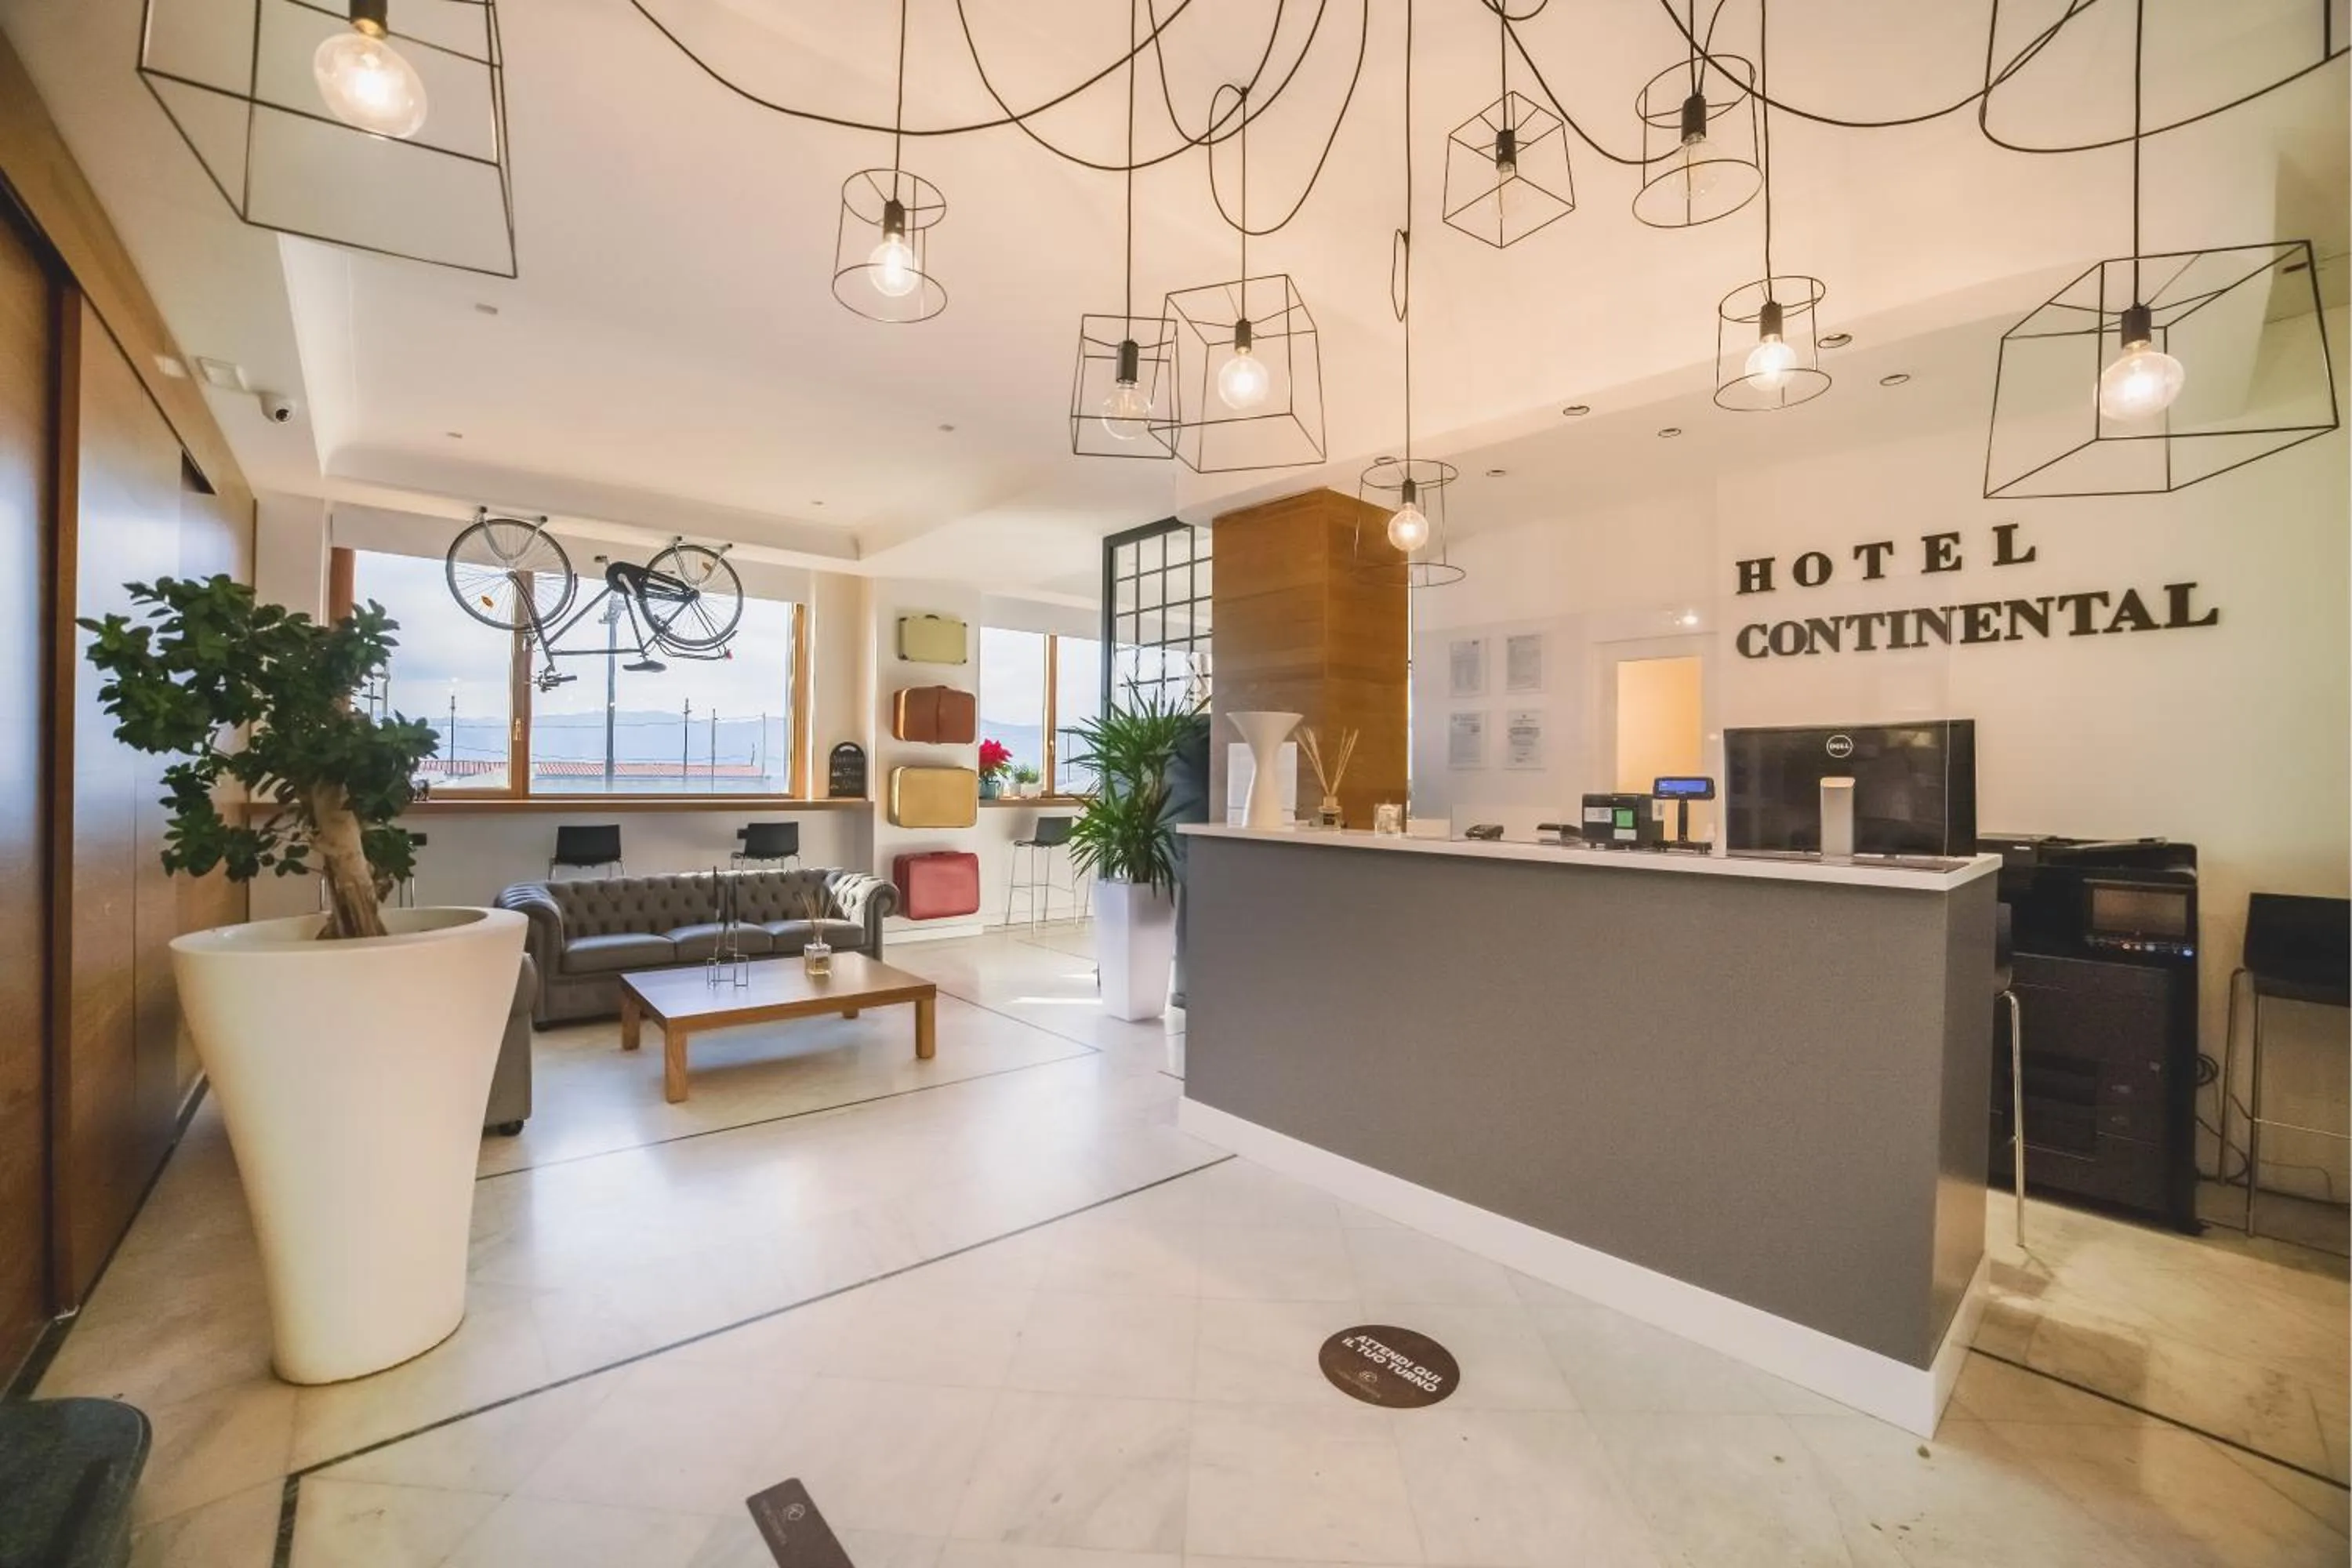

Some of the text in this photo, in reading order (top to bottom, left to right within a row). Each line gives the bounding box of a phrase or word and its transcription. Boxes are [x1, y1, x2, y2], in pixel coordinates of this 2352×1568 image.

[1735, 523, 2037, 594] HOTEL
[1735, 582, 2220, 659] CONTINENTAL
[1341, 1337, 1356, 1348] IL
[1356, 1344, 1387, 1363] TUO
[1387, 1361, 1437, 1392] TURNO
[1355, 1334, 1414, 1368] ATTENDI
[1413, 1365, 1443, 1385] QUI
